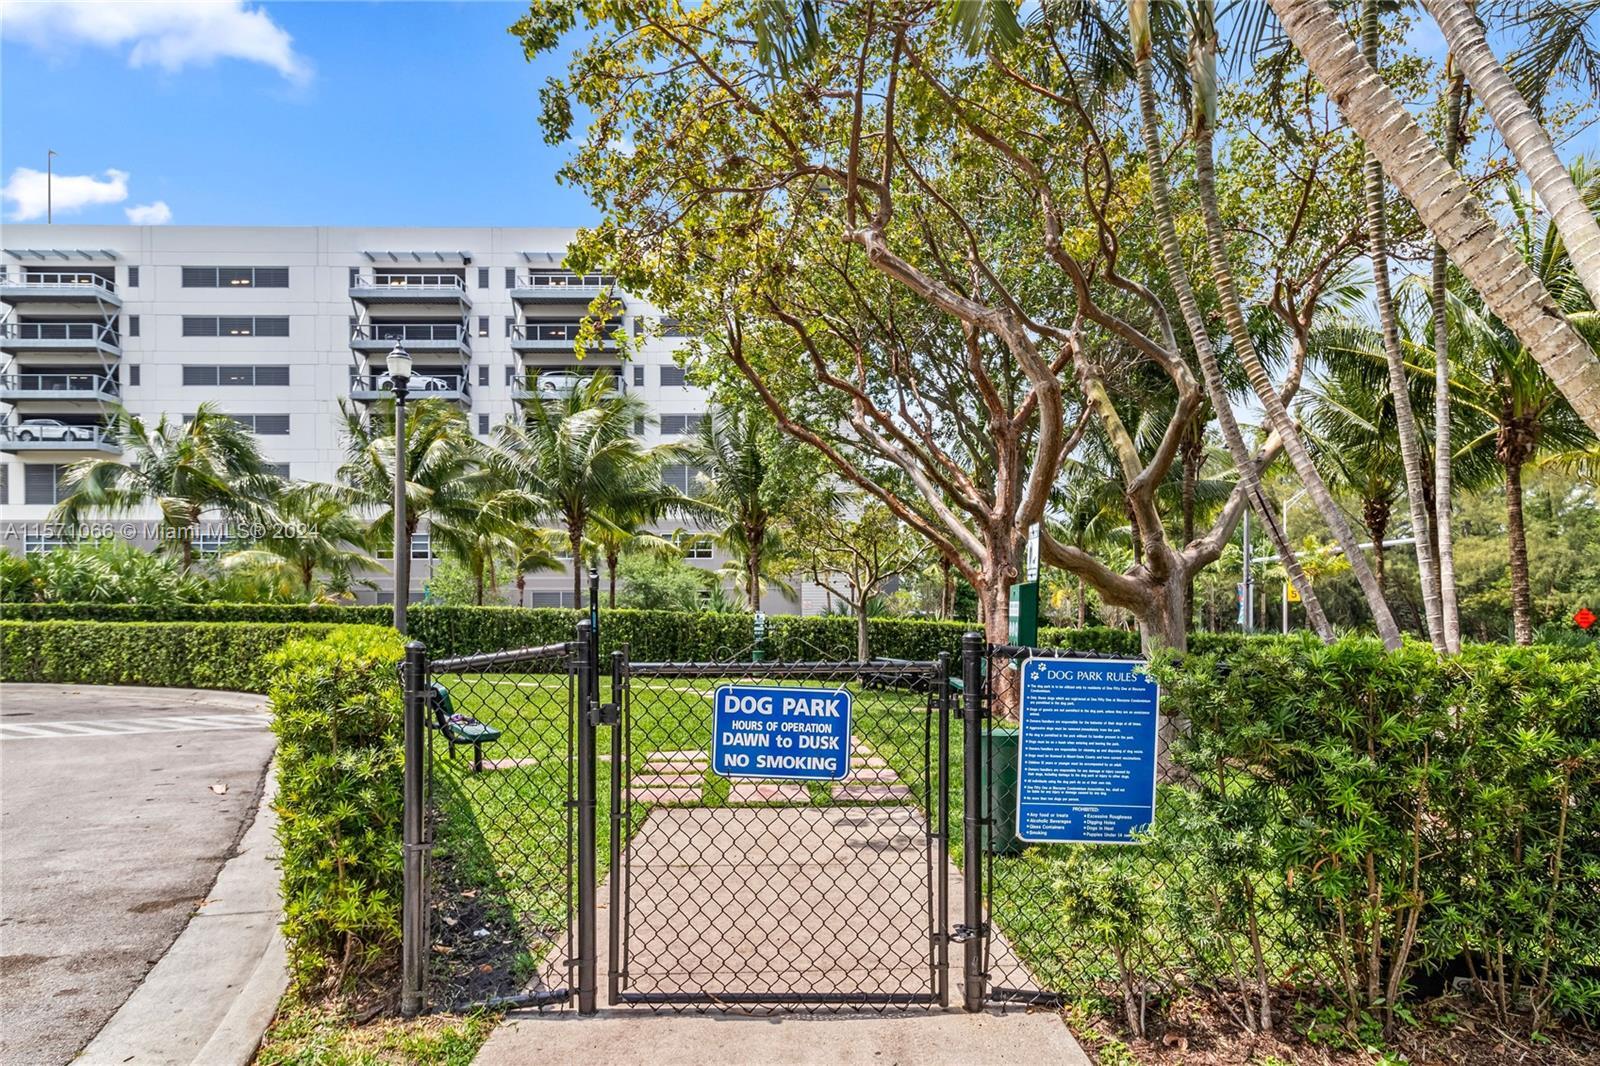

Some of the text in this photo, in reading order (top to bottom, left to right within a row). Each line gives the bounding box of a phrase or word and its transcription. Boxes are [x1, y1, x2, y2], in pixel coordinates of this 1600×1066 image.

[1048, 670, 1137, 682] DOG PARK RULES
[724, 696, 840, 718] DOG PARK
[732, 720, 832, 733] HOURS OF OPERATION
[722, 732, 839, 750] DAWN to DUSK
[724, 754, 837, 770] NO SMOKING
